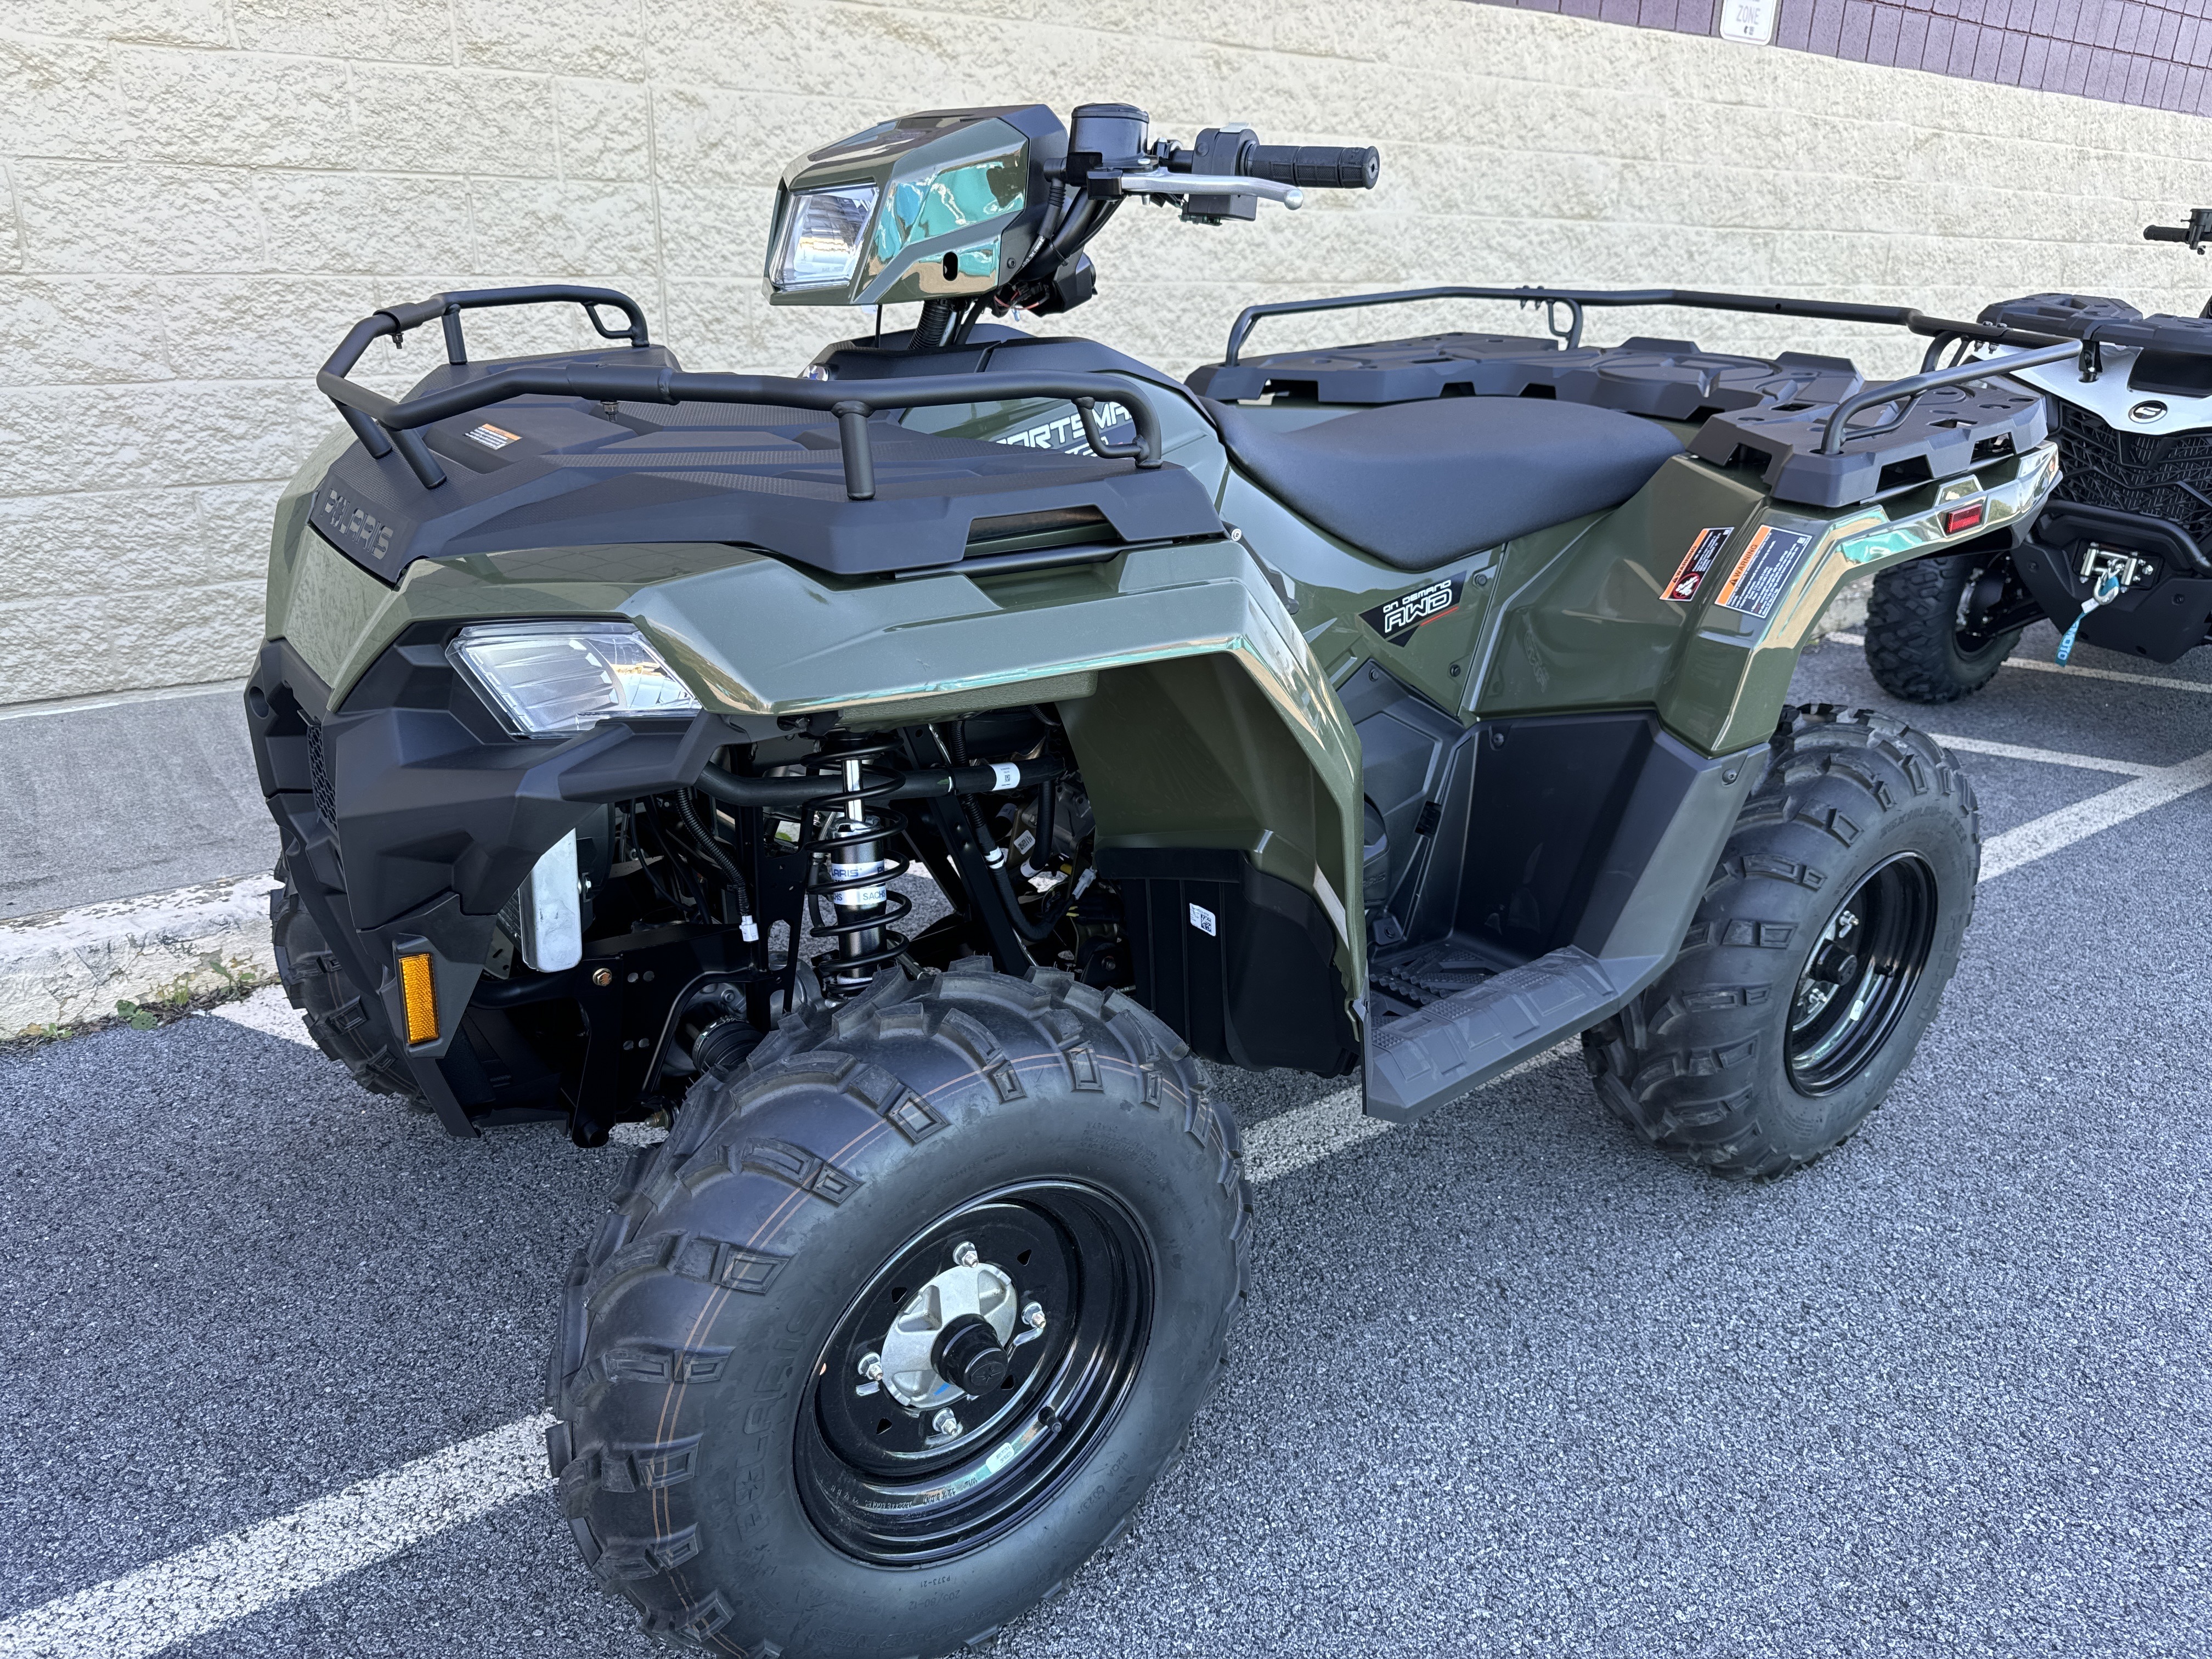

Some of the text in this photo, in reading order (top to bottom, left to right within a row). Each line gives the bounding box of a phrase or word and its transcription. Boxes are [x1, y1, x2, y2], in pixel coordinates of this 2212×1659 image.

[1736, 4, 1761, 25] ZONE
[996, 402, 1132, 449] ORTSMA
[321, 488, 394, 560] POLARIS
[1675, 546, 1697, 577] WARNING
[1735, 544, 1758, 577] WARNING
[1383, 579, 1452, 613] ON DEMAND
[1385, 588, 1452, 633] AWD
[863, 889, 885, 900] SACHS
[735, 1298, 825, 1541] POLARIS
[920, 1574, 951, 1588] P373-21
[908, 1589, 961, 1611] 205/80-12
